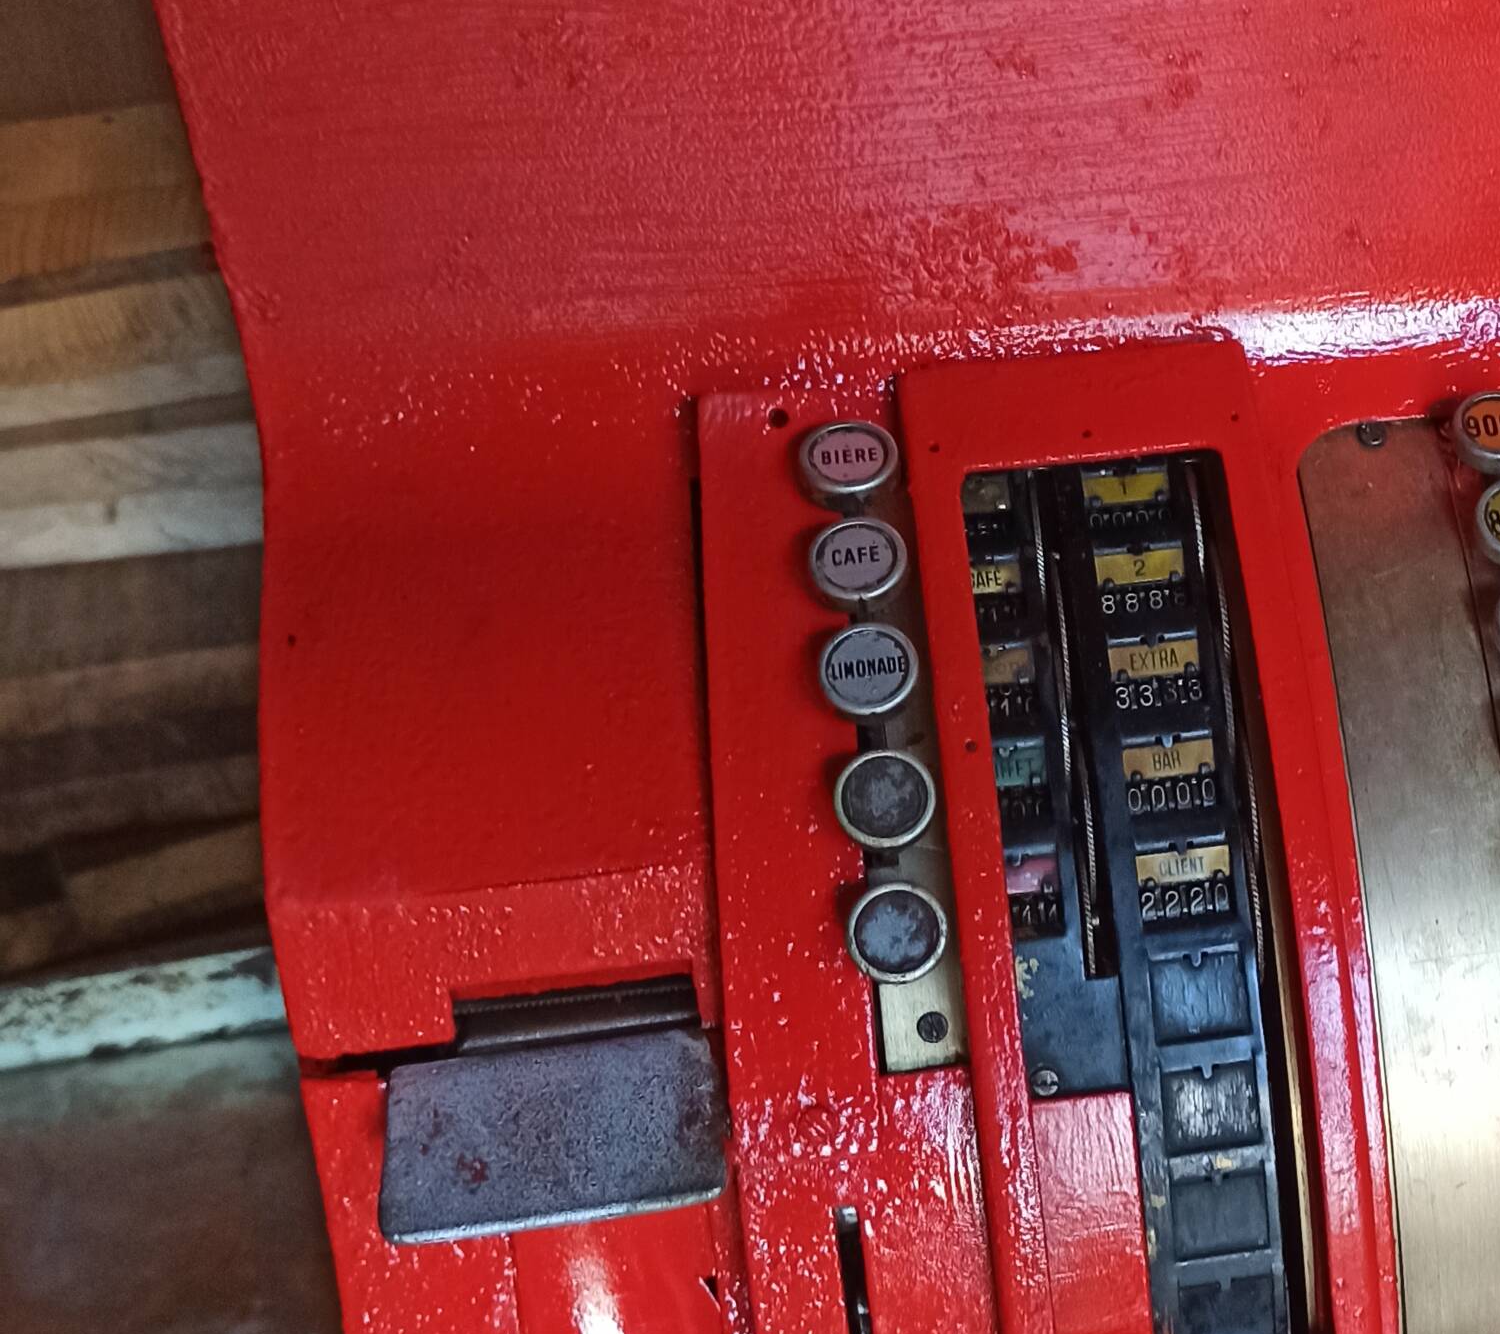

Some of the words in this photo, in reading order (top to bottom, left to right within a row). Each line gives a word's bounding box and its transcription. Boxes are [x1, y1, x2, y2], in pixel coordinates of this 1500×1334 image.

[831, 540, 881, 567] CAFÉ
[1133, 559, 1146, 577] 2
[828, 654, 906, 681] LIMONADE
[1129, 647, 1180, 671] EXTRA
[1152, 750, 1182, 771] BAR
[1158, 854, 1205, 877] CLIENT
